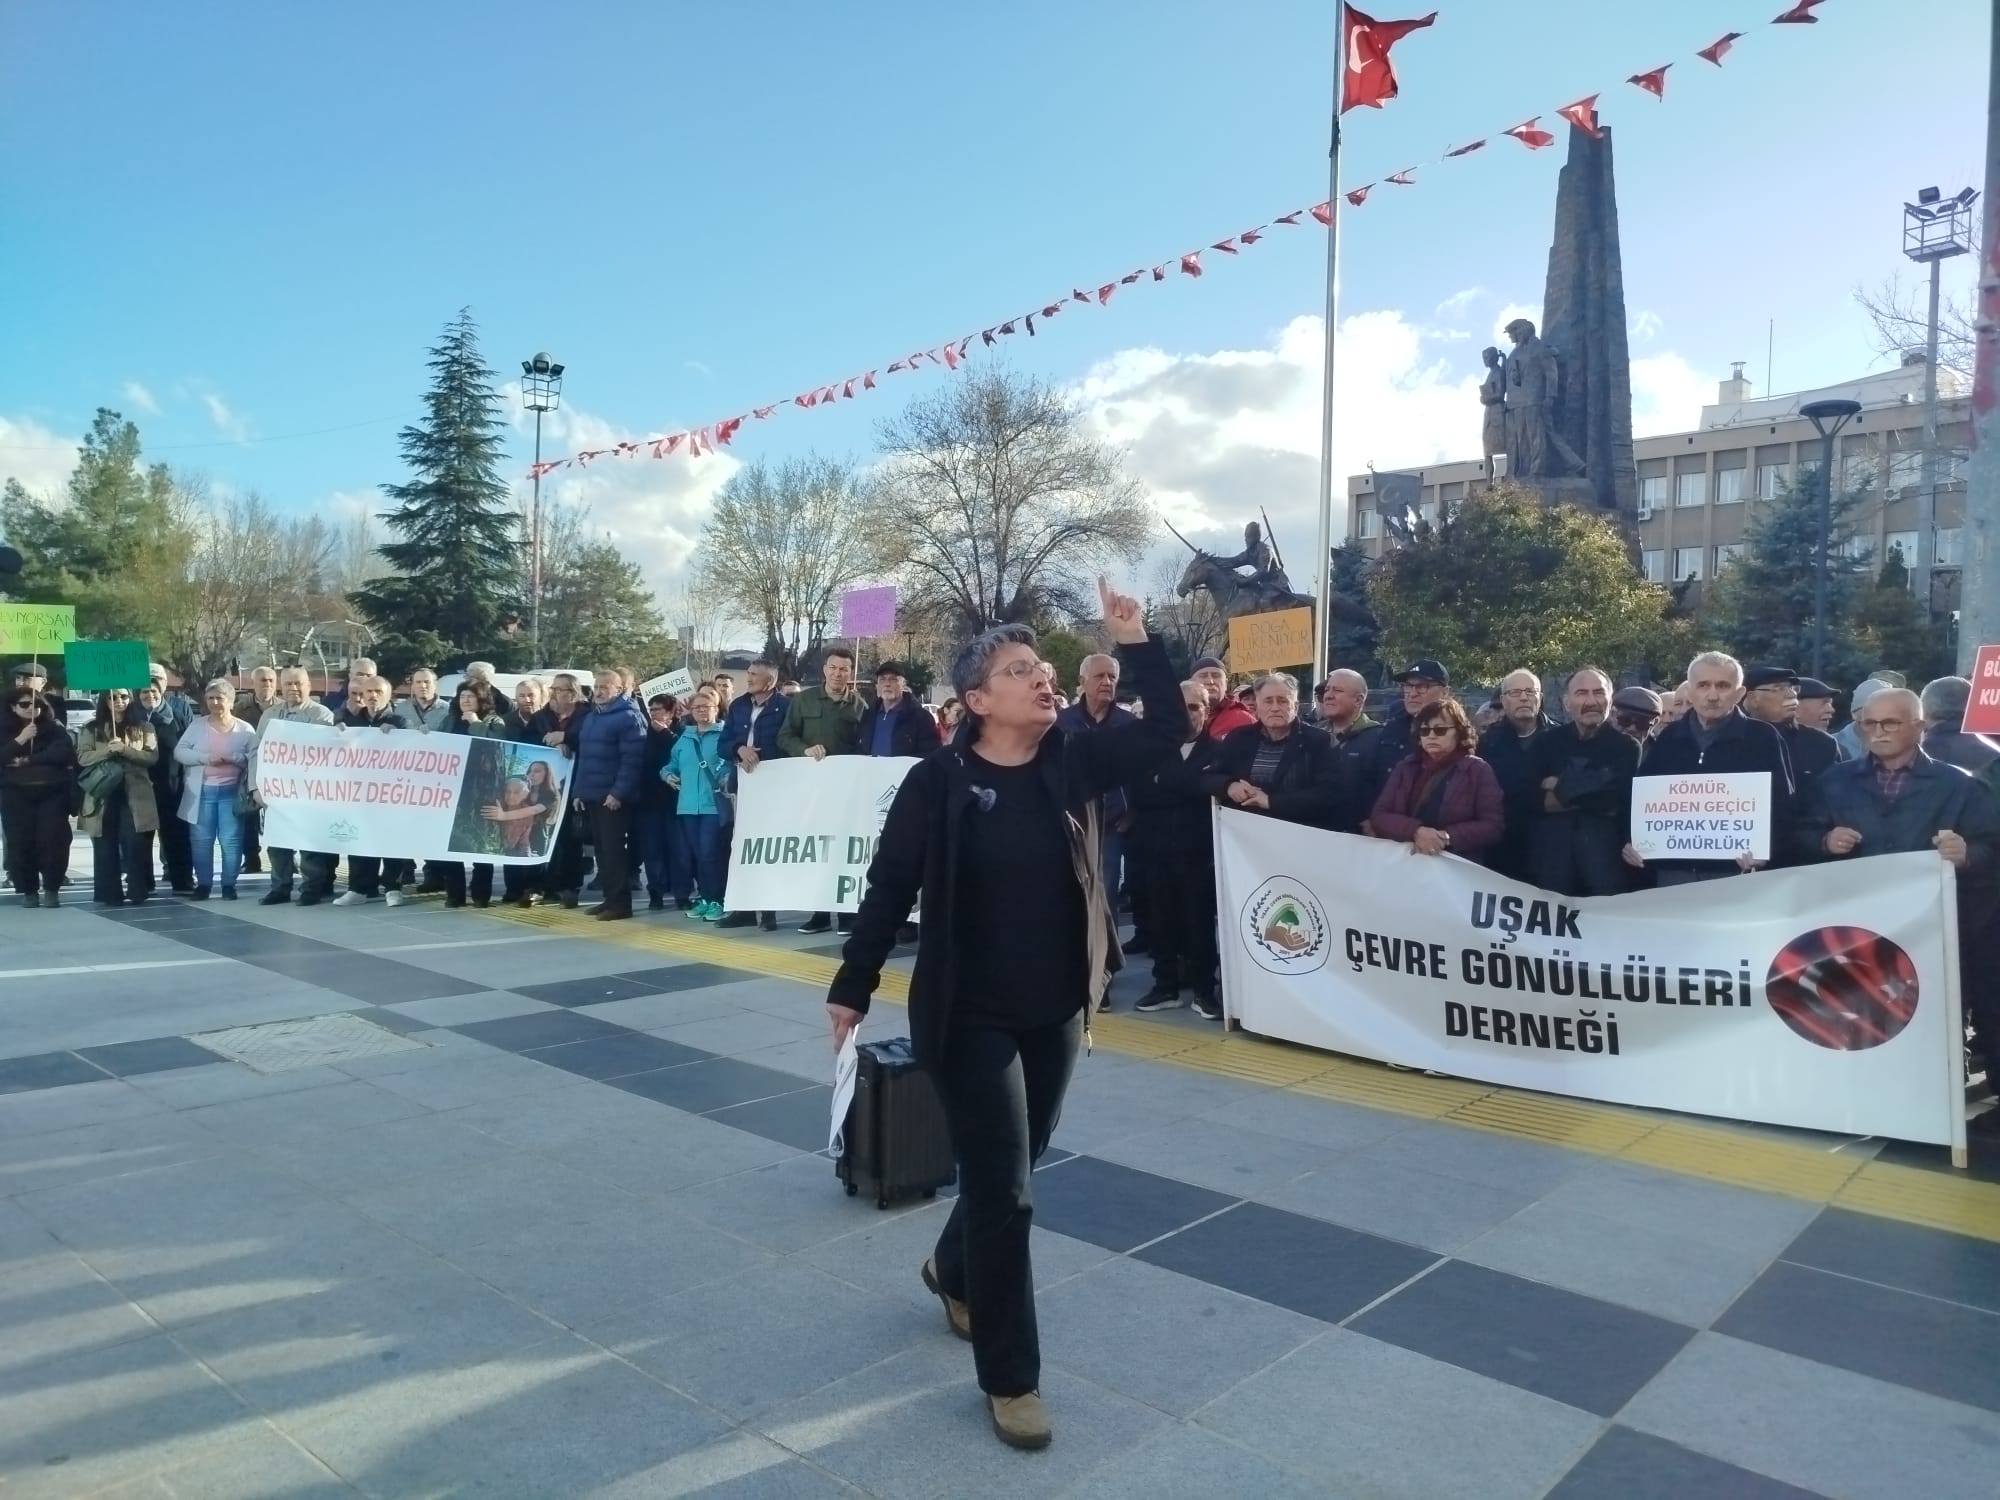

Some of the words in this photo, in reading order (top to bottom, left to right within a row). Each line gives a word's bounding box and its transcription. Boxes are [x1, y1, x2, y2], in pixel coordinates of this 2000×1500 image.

[264, 741, 297, 765] ESRA
[299, 745, 333, 772] IŞIK
[334, 747, 461, 776] ONURUMUZDUR
[264, 777, 298, 799] ASLA
[304, 778, 361, 803] YALNIZ
[366, 777, 453, 808] DEĞİLDİR
[1669, 780, 1730, 795] KÖMÜR,
[1644, 801, 1700, 814] MADEN
[1704, 798, 1756, 815] GEÇİCİ
[1645, 820, 1706, 832] TOPRAK
[1709, 819, 1729, 831] VE
[1733, 819, 1754, 831] SU
[741, 835, 836, 865] MURAT
[1666, 835, 1750, 850] ÖMÜRLÜK!
[1471, 891, 1582, 943] UŞAK
[1345, 928, 1448, 981] ÇEVRE
[1461, 943, 1752, 1007] GÖNÜLLÜLERİ
[1445, 1000, 1620, 1056] DERNEĞİ
